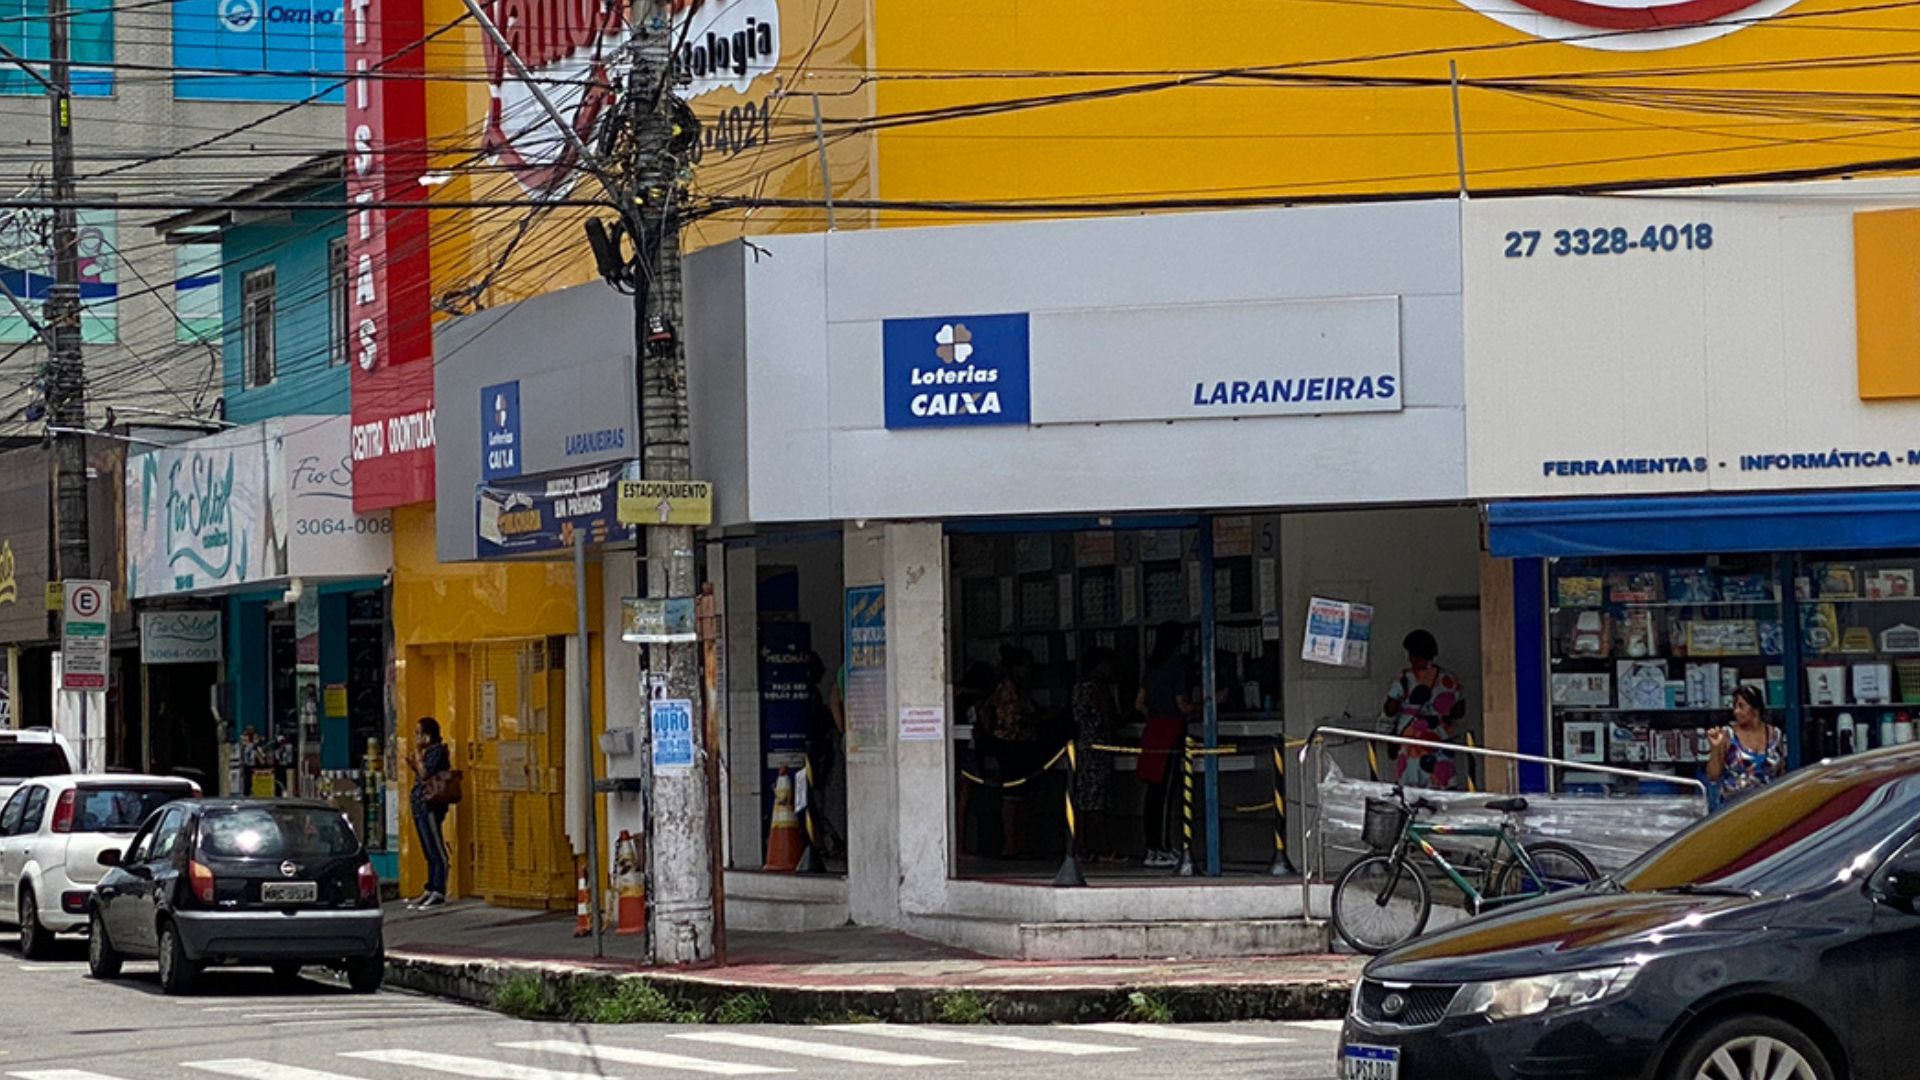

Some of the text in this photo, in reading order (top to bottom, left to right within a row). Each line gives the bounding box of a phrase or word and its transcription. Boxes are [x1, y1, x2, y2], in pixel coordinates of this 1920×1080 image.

[676, 16, 772, 76] tologia
[1505, 223, 1714, 257] 27 3328-4018
[911, 366, 998, 386] Loterias
[1194, 375, 1395, 406] LARANJEIRAS
[911, 392, 1001, 416] CAIXA
[352, 419, 384, 461] CENTRO
[565, 428, 625, 456] LARANJEIRAS
[488, 449, 515, 469] CAIXA
[1543, 456, 1708, 477] FERRAMENTAS
[1740, 449, 1891, 471] INFORMÁTICA
[292, 456, 328, 490] Fio
[623, 482, 708, 499] ESTACIONAMENTO
[296, 518, 393, 535] 3064-008
[80, 593, 92, 610] E
[653, 711, 689, 732] OURO
